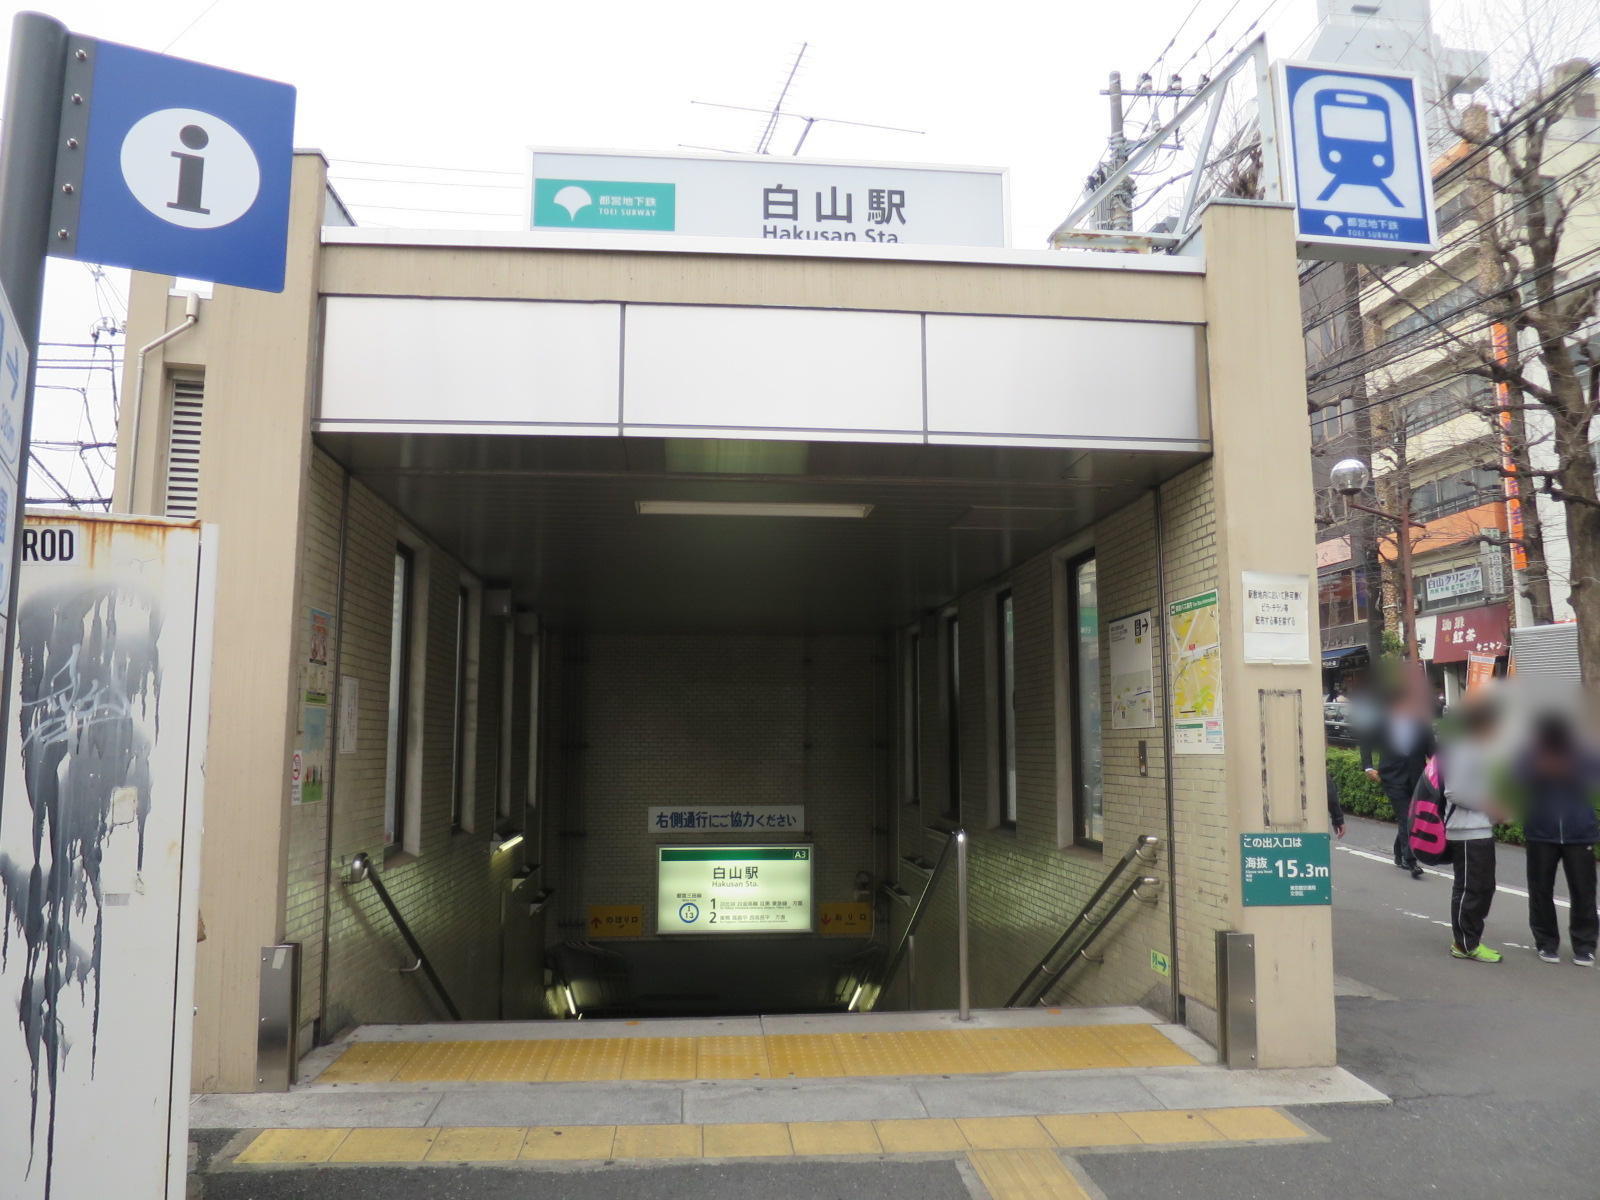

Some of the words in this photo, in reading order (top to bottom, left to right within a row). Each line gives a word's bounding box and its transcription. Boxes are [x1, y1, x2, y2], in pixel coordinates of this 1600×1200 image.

[599, 196, 656, 206] 都営地下鉄
[763, 184, 906, 225] 白山駅
[1347, 218, 1398, 230] 都営地下鉄
[763, 224, 857, 242] Hakusan
[1368, 231, 1399, 239] SUBWAY
[1428, 569, 1480, 589] 白山クリニック
[1452, 628, 1476, 644] 紅茶
[656, 811, 796, 828] 右側通行にご協力ください
[1243, 837, 1302, 848] この出入口は
[713, 866, 759, 880] 白山駅
[1245, 856, 1268, 869] 海抜
[1274, 859, 1329, 878] 15.3m
[710, 898, 716, 909] 1
[709, 912, 716, 923] 2
